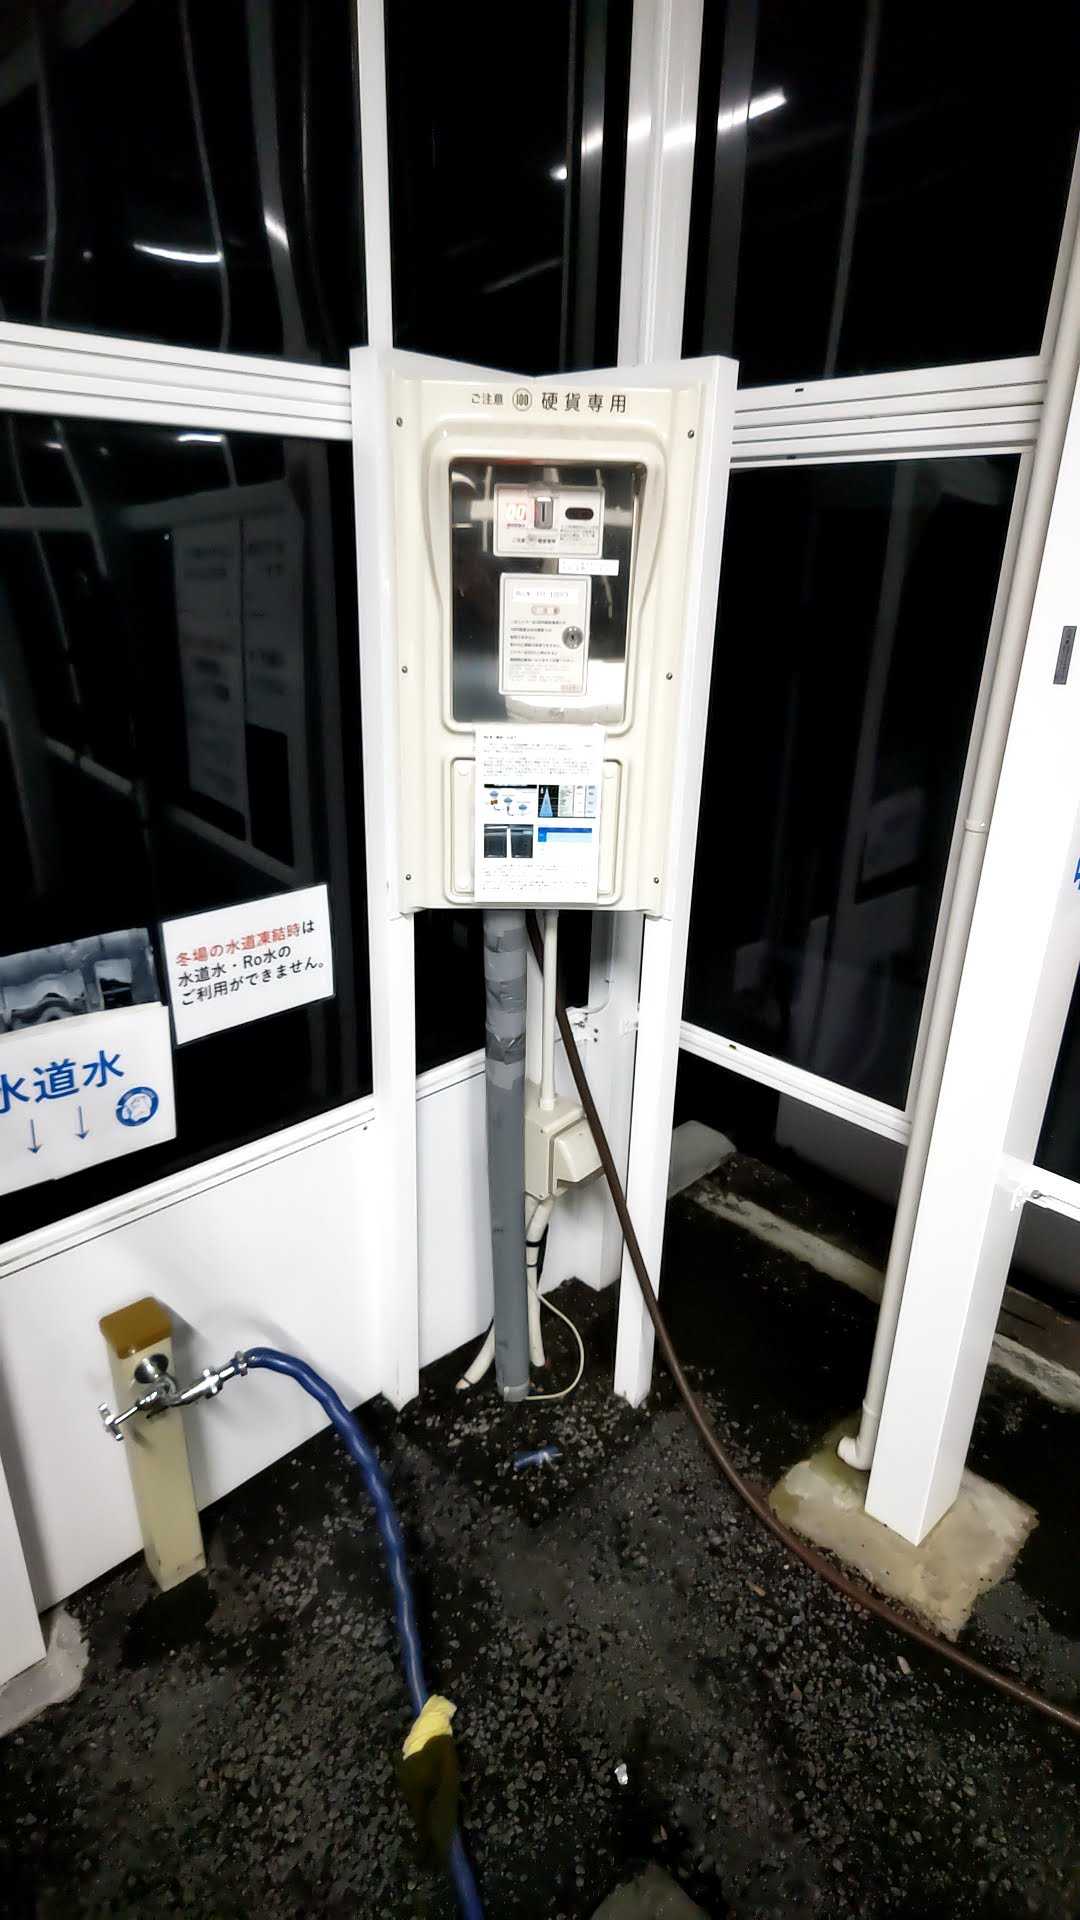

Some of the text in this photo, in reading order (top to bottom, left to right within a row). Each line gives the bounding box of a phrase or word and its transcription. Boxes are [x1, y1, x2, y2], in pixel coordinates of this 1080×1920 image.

[471, 392, 504, 406] ご注意
[541, 391, 627, 413] 硬貨専用
[176, 920, 315, 967] 冬場の水道凍結時は
[182, 956, 324, 1006] ご利用ができません。
[0, 1050, 125, 1114] 水道水
